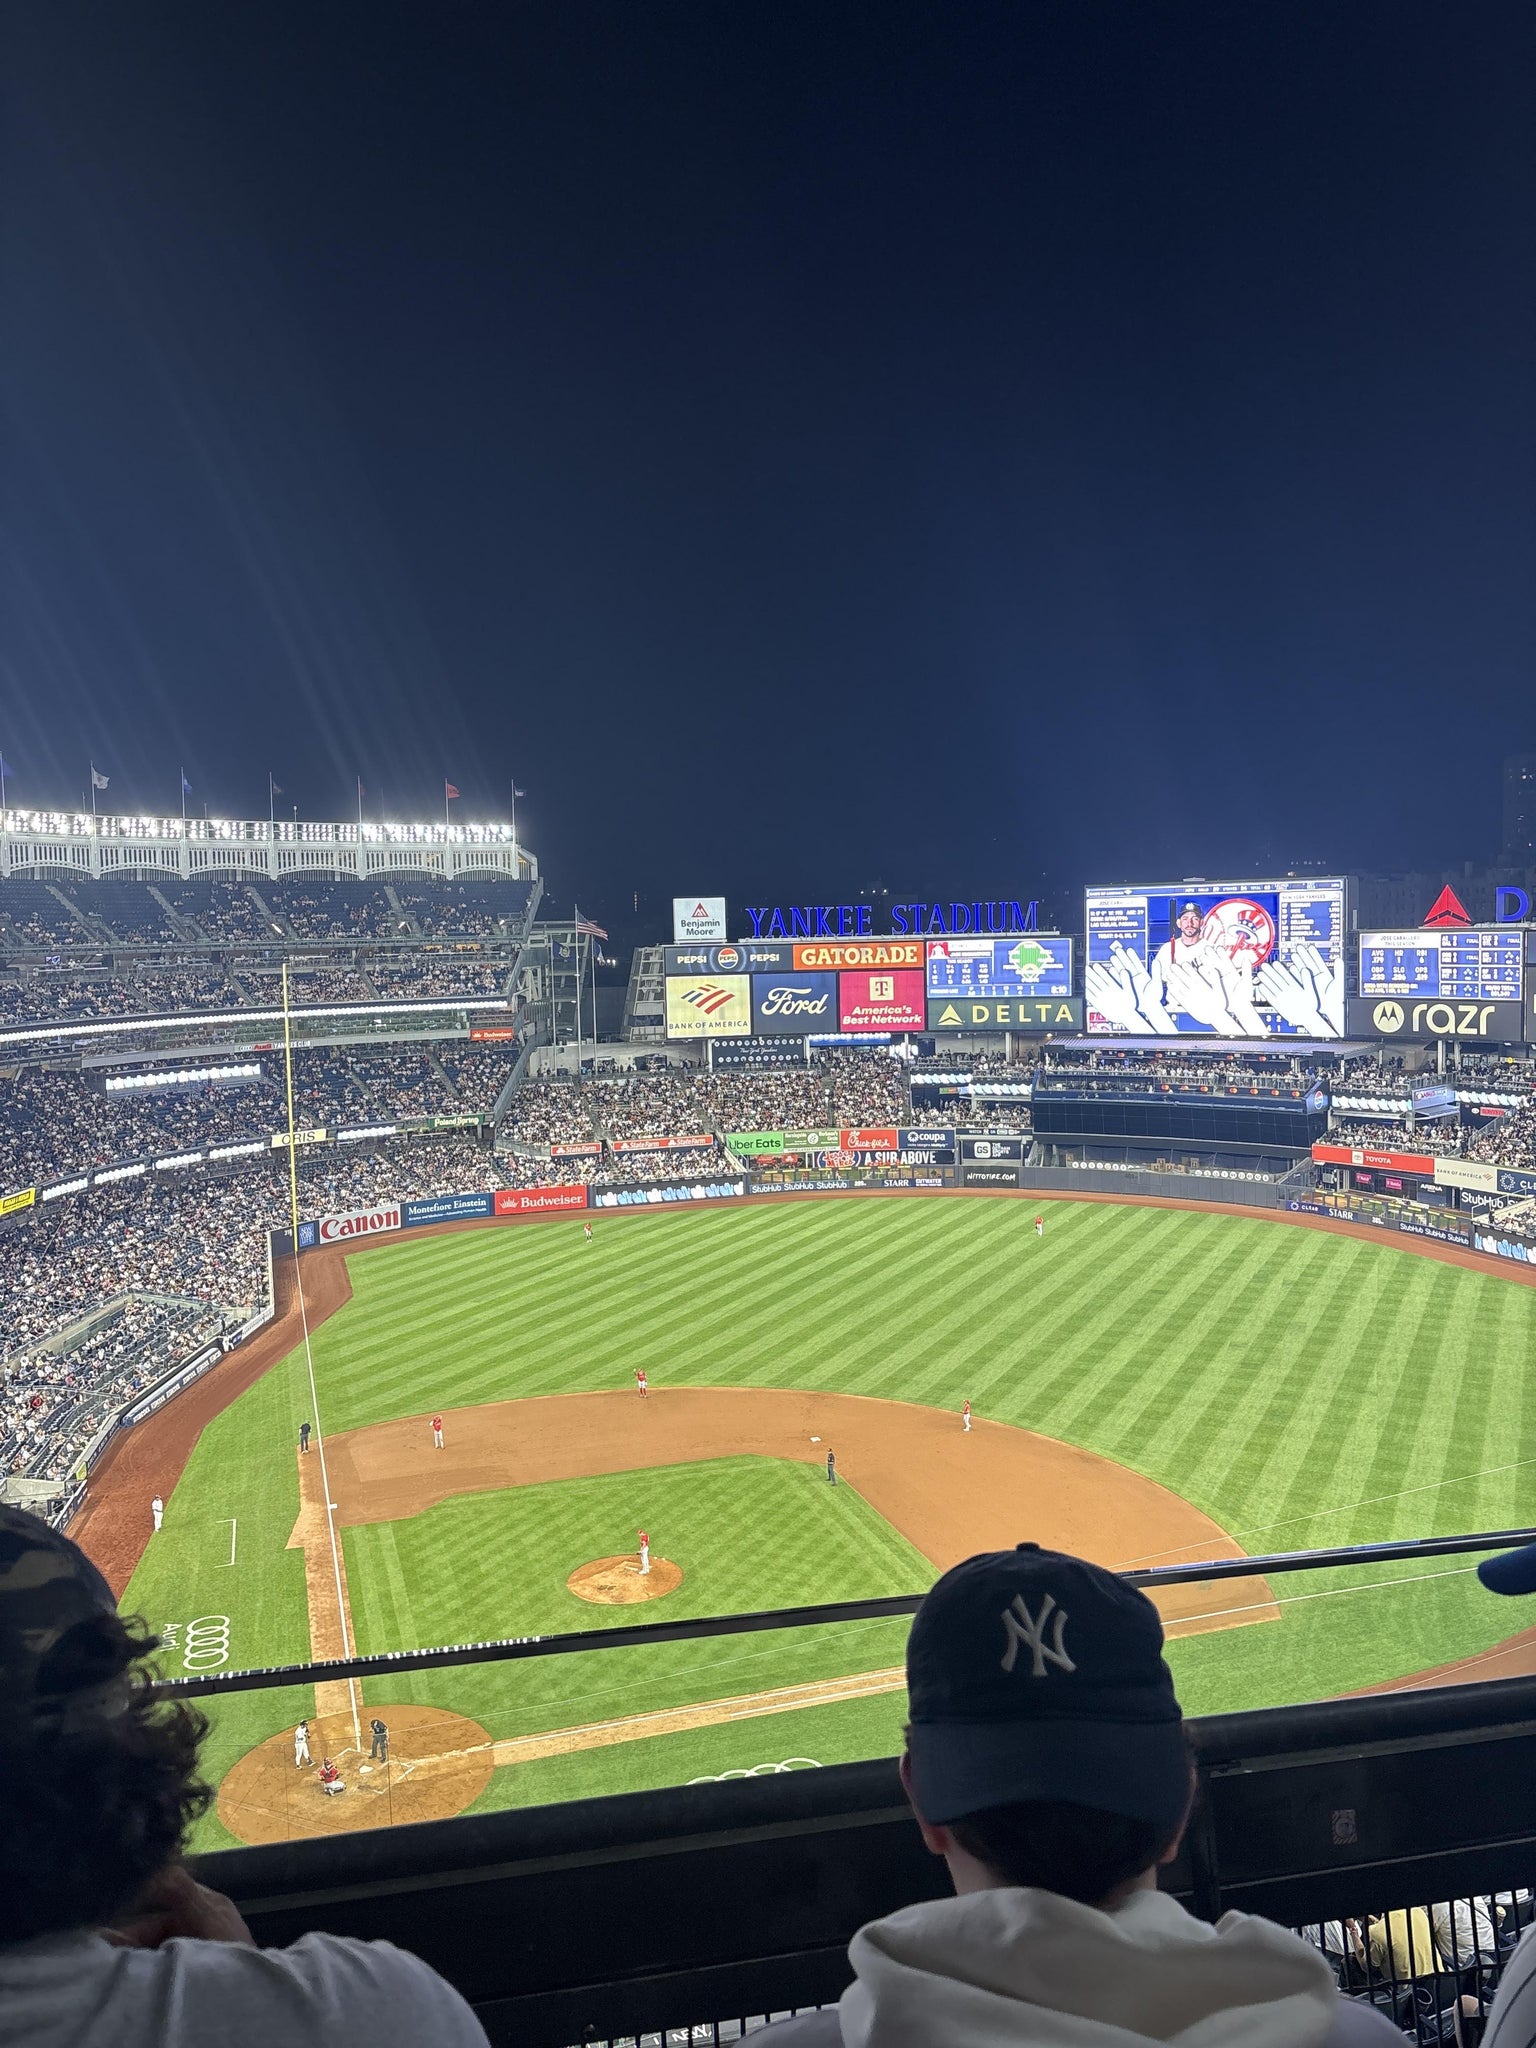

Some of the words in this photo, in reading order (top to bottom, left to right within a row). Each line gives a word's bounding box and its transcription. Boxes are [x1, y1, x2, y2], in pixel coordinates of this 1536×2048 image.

[1496, 886, 1530, 922] D
[681, 919, 720, 928] Benjamin
[745, 905, 872, 939] YANKEE
[891, 901, 1039, 936] STADIUM
[677, 955, 707, 964] PEPSI
[750, 953, 780, 962] PEPSI
[801, 946, 917, 966] GATORADE
[761, 987, 829, 1015] Ford
[851, 1006, 912, 1015] America's
[972, 1003, 1074, 1023] DELTA
[669, 1022, 693, 1030] BANK
[708, 1020, 748, 1029] AMERICA
[842, 1016, 869, 1024] Best
[871, 1014, 922, 1024] Network
[1412, 1003, 1496, 1035] razr
[434, 1117, 456, 1127] Poland
[457, 1116, 479, 1126] Spring
[281, 1131, 315, 1145] ORIS
[729, 1140, 754, 1150] Uber
[755, 1138, 781, 1148] Eats
[919, 1132, 945, 1143] coupa
[864, 1152, 872, 1166] A
[874, 1151, 898, 1165] SUB
[901, 1150, 937, 1165] ABOVE
[1365, 1155, 1391, 1165] TOYOTA
[884, 1179, 909, 1187] STARR
[967, 1172, 1016, 1181] NITTOTIRE.COM
[752, 1185, 782, 1193] StubHub
[784, 1182, 814, 1191] StubHub
[816, 1181, 847, 1189] StubHub
[408, 1202, 452, 1215] Montefiore
[453, 1198, 487, 1209] Einstein
[520, 1194, 583, 1208] Budweiser
[1461, 1191, 1504, 1208] StubHub
[1328, 1208, 1353, 1220] STARR
[321, 1210, 399, 1239] Canon
[1400, 1223, 1424, 1234] StubHub
[1425, 1228, 1446, 1239] StubHub
[1447, 1233, 1470, 1245] StubHub
[160, 1623, 183, 1652] Audi
[1000, 1592, 1077, 1677] NY
